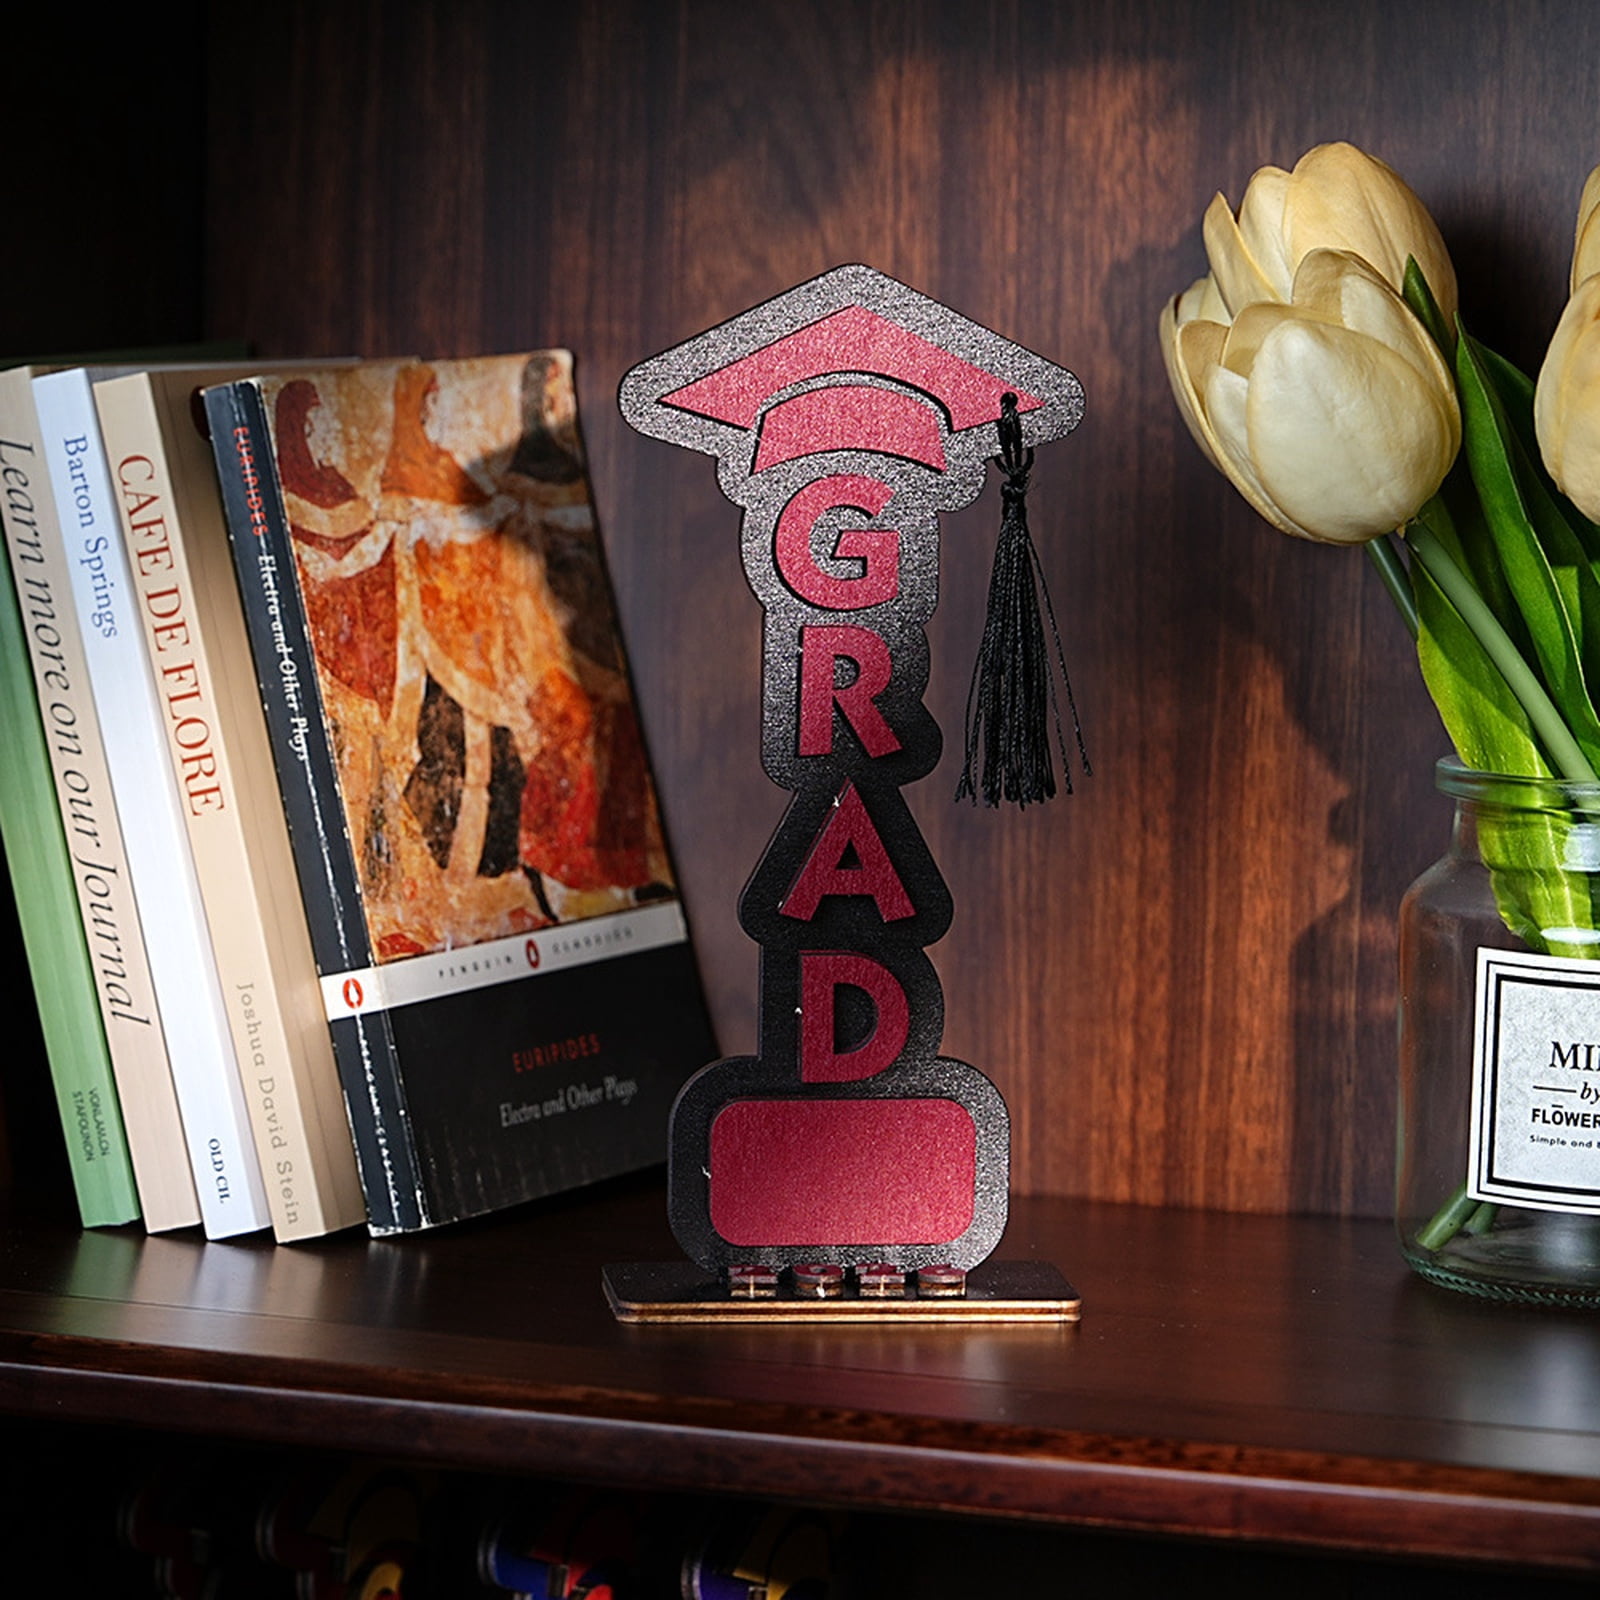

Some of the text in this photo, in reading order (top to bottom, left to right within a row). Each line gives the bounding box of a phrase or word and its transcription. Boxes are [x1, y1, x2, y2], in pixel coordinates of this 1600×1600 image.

[233, 425, 269, 537] EURIPIDES
[64, 433, 118, 639] Barton Springs
[118, 454, 226, 817] CAFE DE FLORE
[279, 660, 300, 711] Other
[0, 439, 152, 1026] Learn more on our Journal
[288, 717, 309, 762] Plays
[772, 473, 915, 1084] GRAD
[512, 1033, 600, 1073] EURIPIDES
[1549, 1041, 1600, 1072] MI
[236, 982, 299, 1225] Joshua David Stein
[1580, 1081, 1600, 1105] by
[208, 1137, 225, 1173] OLD
[1530, 1134, 1567, 1147] Simple
[1571, 1140, 1593, 1149] and
